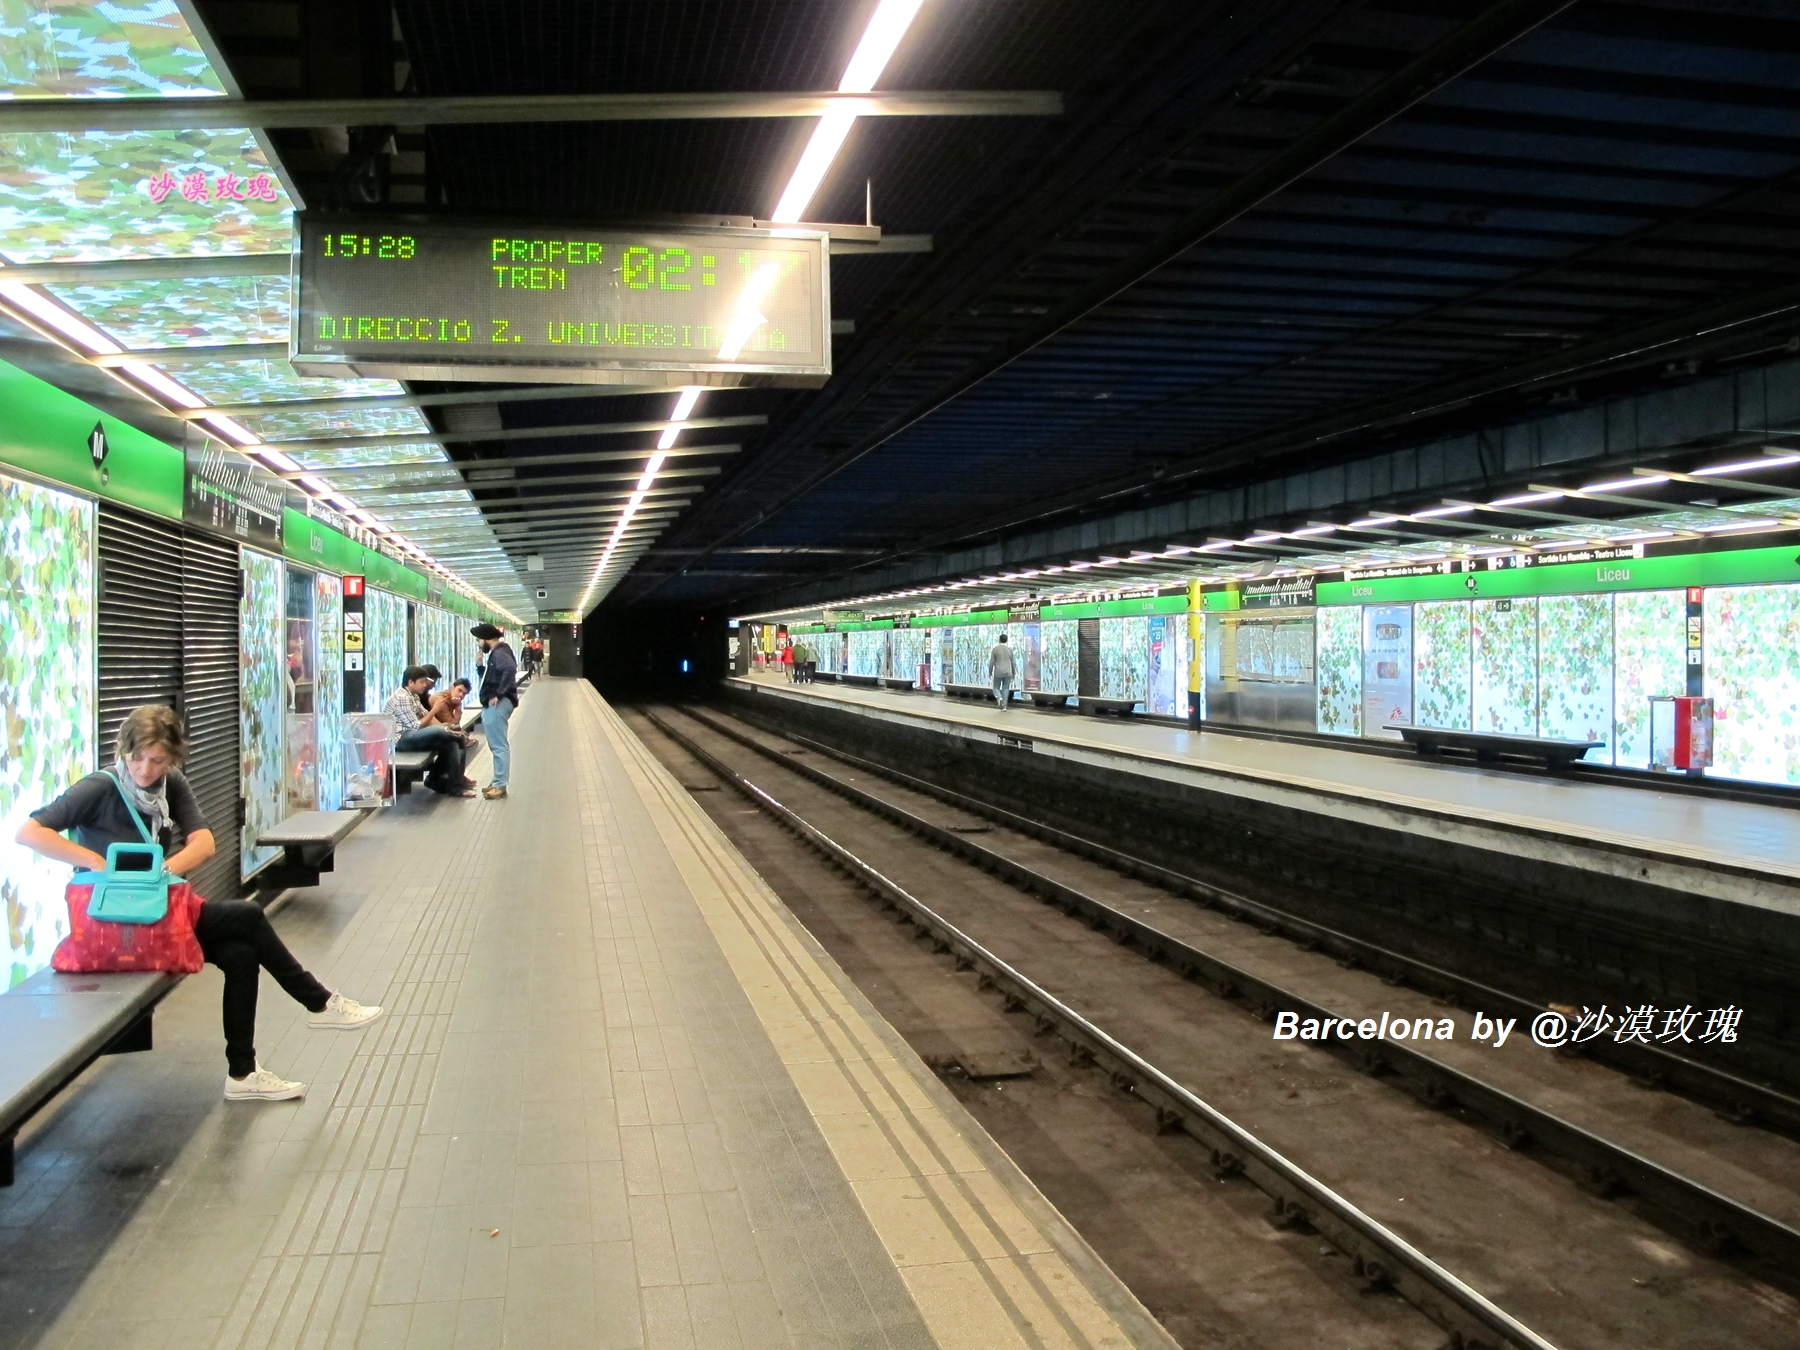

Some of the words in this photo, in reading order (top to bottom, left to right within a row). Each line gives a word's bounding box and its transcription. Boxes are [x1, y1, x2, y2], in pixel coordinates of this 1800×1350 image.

[323, 234, 416, 258] 15:28
[491, 238, 603, 264] PROPER
[492, 265, 567, 290] TREN
[491, 319, 523, 343] Z.
[1596, 567, 1630, 582] Liceu
[1352, 585, 1373, 597] Liceu
